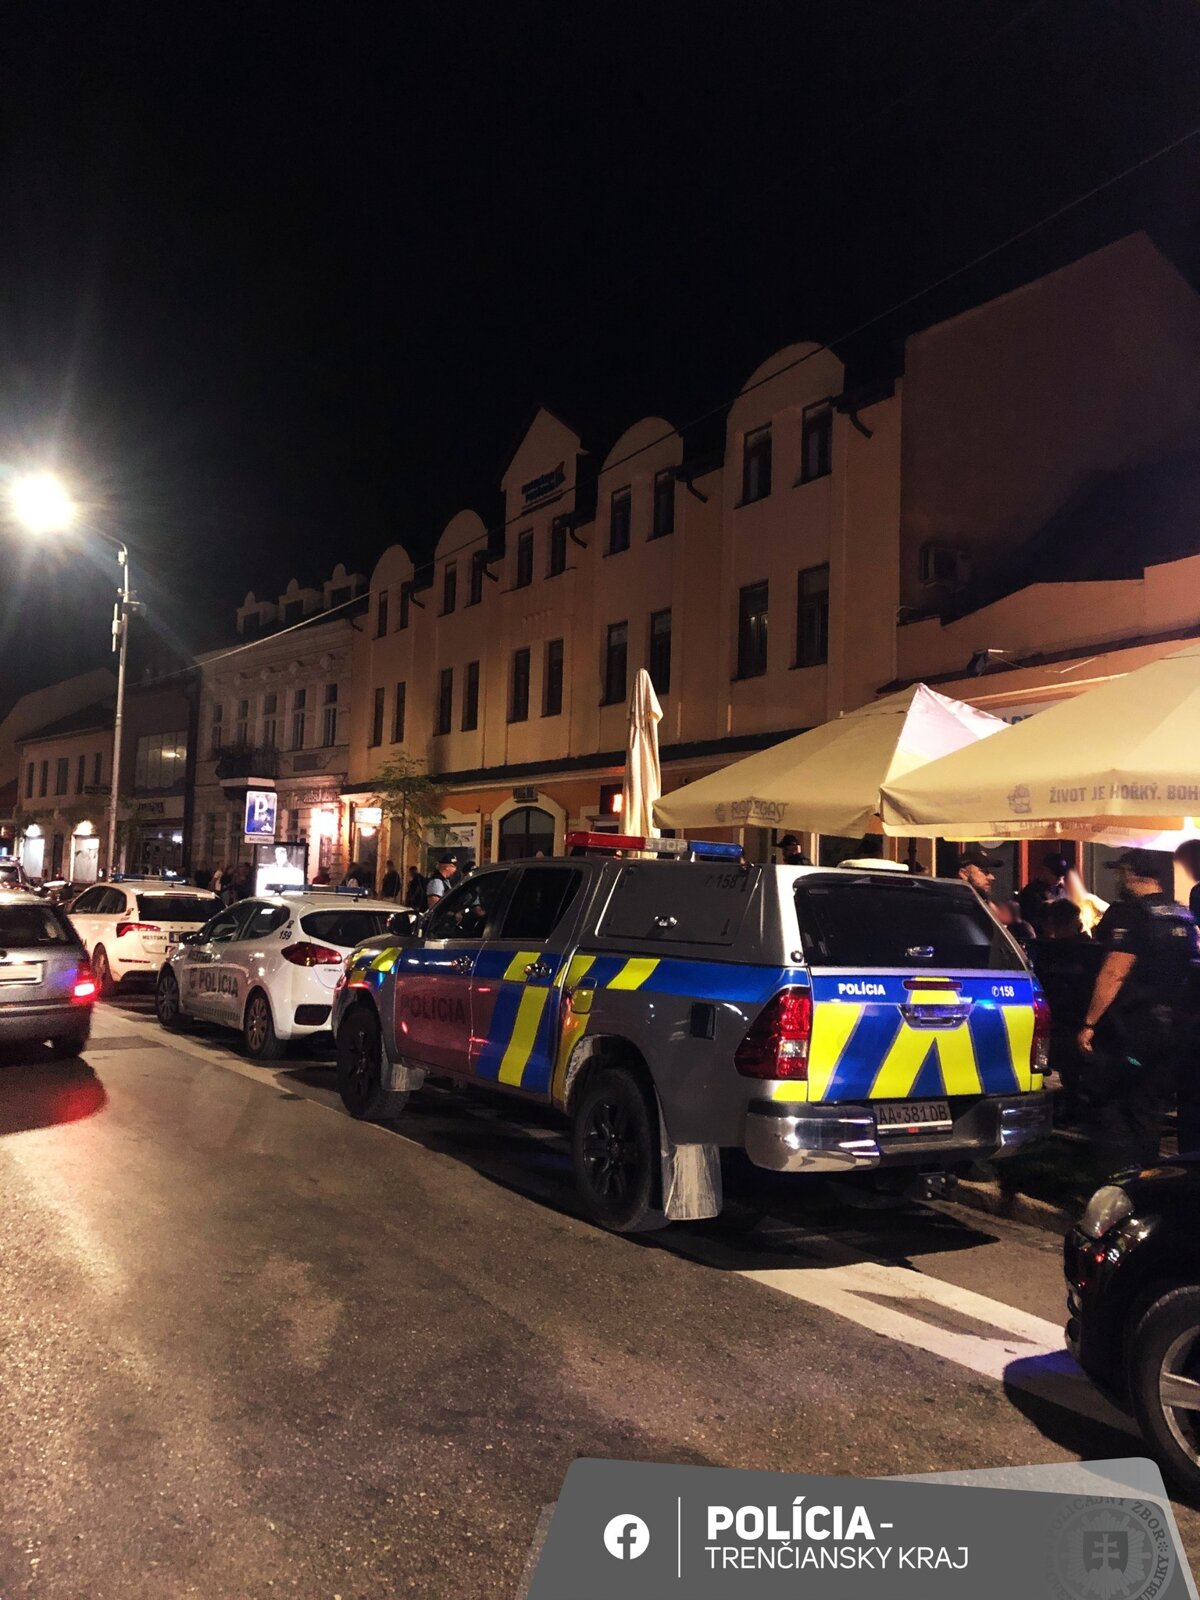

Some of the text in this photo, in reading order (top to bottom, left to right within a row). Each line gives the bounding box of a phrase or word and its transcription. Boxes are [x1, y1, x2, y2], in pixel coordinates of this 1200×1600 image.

[1050, 787, 1087, 803] ŽIVOT
[1091, 785, 1105, 800] JE
[716, 874, 737, 888] 158
[838, 981, 886, 996] POLÍCIA
[999, 986, 1015, 997] 158
